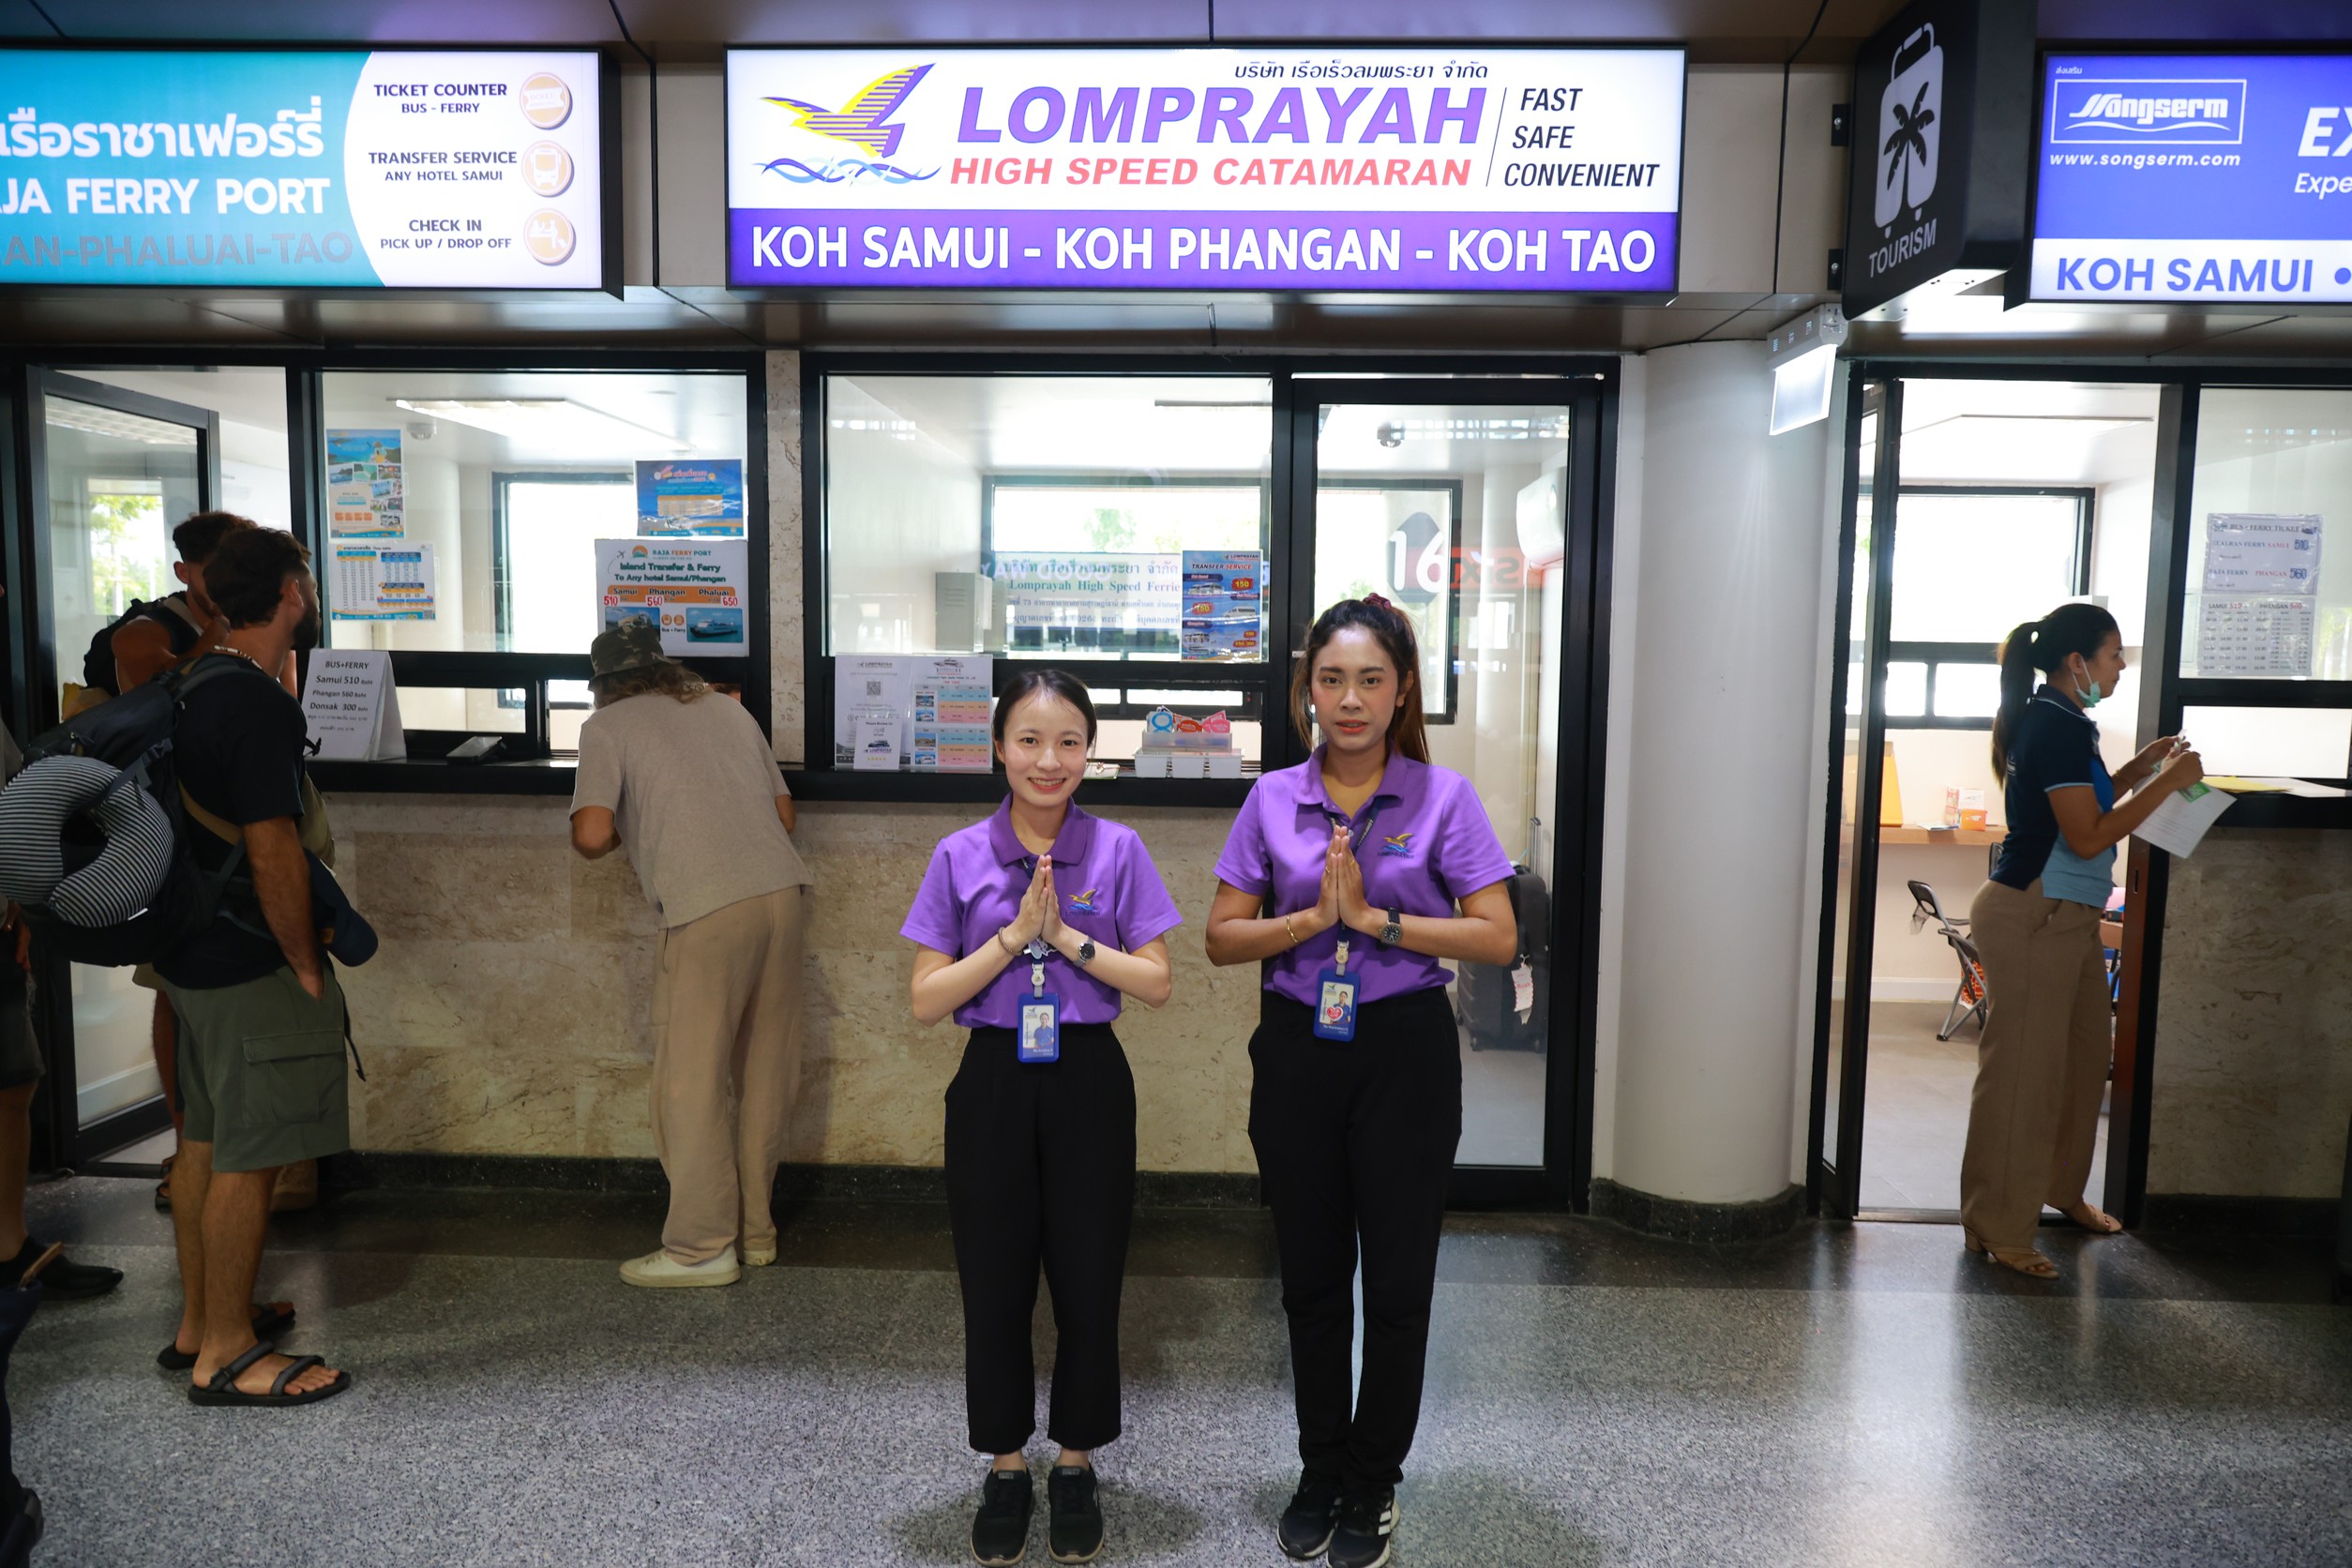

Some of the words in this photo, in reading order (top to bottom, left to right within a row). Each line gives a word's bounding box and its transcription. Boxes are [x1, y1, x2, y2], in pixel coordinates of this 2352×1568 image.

[1235, 59, 1285, 79] บริษัท
[1291, 58, 1435, 79] เรือเร็วลมพระยา
[1442, 59, 1489, 79] จำกัด
[373, 83, 429, 97] TICKET
[433, 83, 507, 97] COUNTER
[1520, 87, 1583, 112] FAST
[401, 103, 428, 113] BUS
[440, 102, 480, 113] FERRY
[957, 85, 1487, 143] LOMPRAYAH
[1512, 126, 1576, 150] SAFE
[368, 151, 448, 164] TRANSFER
[453, 151, 518, 164] SERVICE
[2049, 153, 2241, 170] www.songserm.com
[384, 171, 412, 181] ANY
[416, 171, 458, 181] HOTEL
[461, 171, 503, 181] SAMUI
[950, 158, 1053, 185] HIGH
[1065, 157, 1199, 186] SPEED
[1213, 158, 1472, 187] CATAMARAN
[1503, 162, 1660, 188] CONVENIENT
[0, 177, 53, 215] JA
[67, 178, 200, 214] FERRY
[217, 177, 331, 215] PORT
[408, 219, 460, 232] CHECK
[466, 219, 483, 232] IN
[0, 231, 354, 267] AN-PHALUAI-TAO
[380, 238, 411, 249] PICK
[415, 238, 433, 249] UP
[447, 238, 484, 249] DROP
[487, 237, 513, 249] OFF
[751, 225, 848, 269] KOH
[863, 225, 1010, 270] SAMUI
[1056, 227, 1153, 271] KOH
[1169, 227, 1401, 273] PHANGAN
[1448, 228, 1548, 273] KOH
[1560, 229, 1657, 274] TAO
[1868, 218, 1937, 279] TOURISM
[2057, 257, 2155, 292] KOH
[2166, 257, 2314, 294] SAMUI
[1388, 530, 1445, 594] 16
[613, 587, 638, 596] Samui
[649, 587, 686, 596] Phangan
[699, 588, 730, 596] Phaluai
[1008, 580, 1072, 593] Lomprayah
[1078, 580, 1104, 593] High
[1109, 580, 1141, 594] Speed
[604, 596, 619, 607] 510
[646, 596, 663, 607] 560
[722, 596, 738, 607] 650
[324, 660, 369, 670] BUS+FERRY
[315, 675, 342, 685] Samui
[343, 676, 359, 686] 510
[312, 689, 339, 699] Phangan
[309, 701, 339, 711] Donsak
[342, 703, 356, 712] 300
